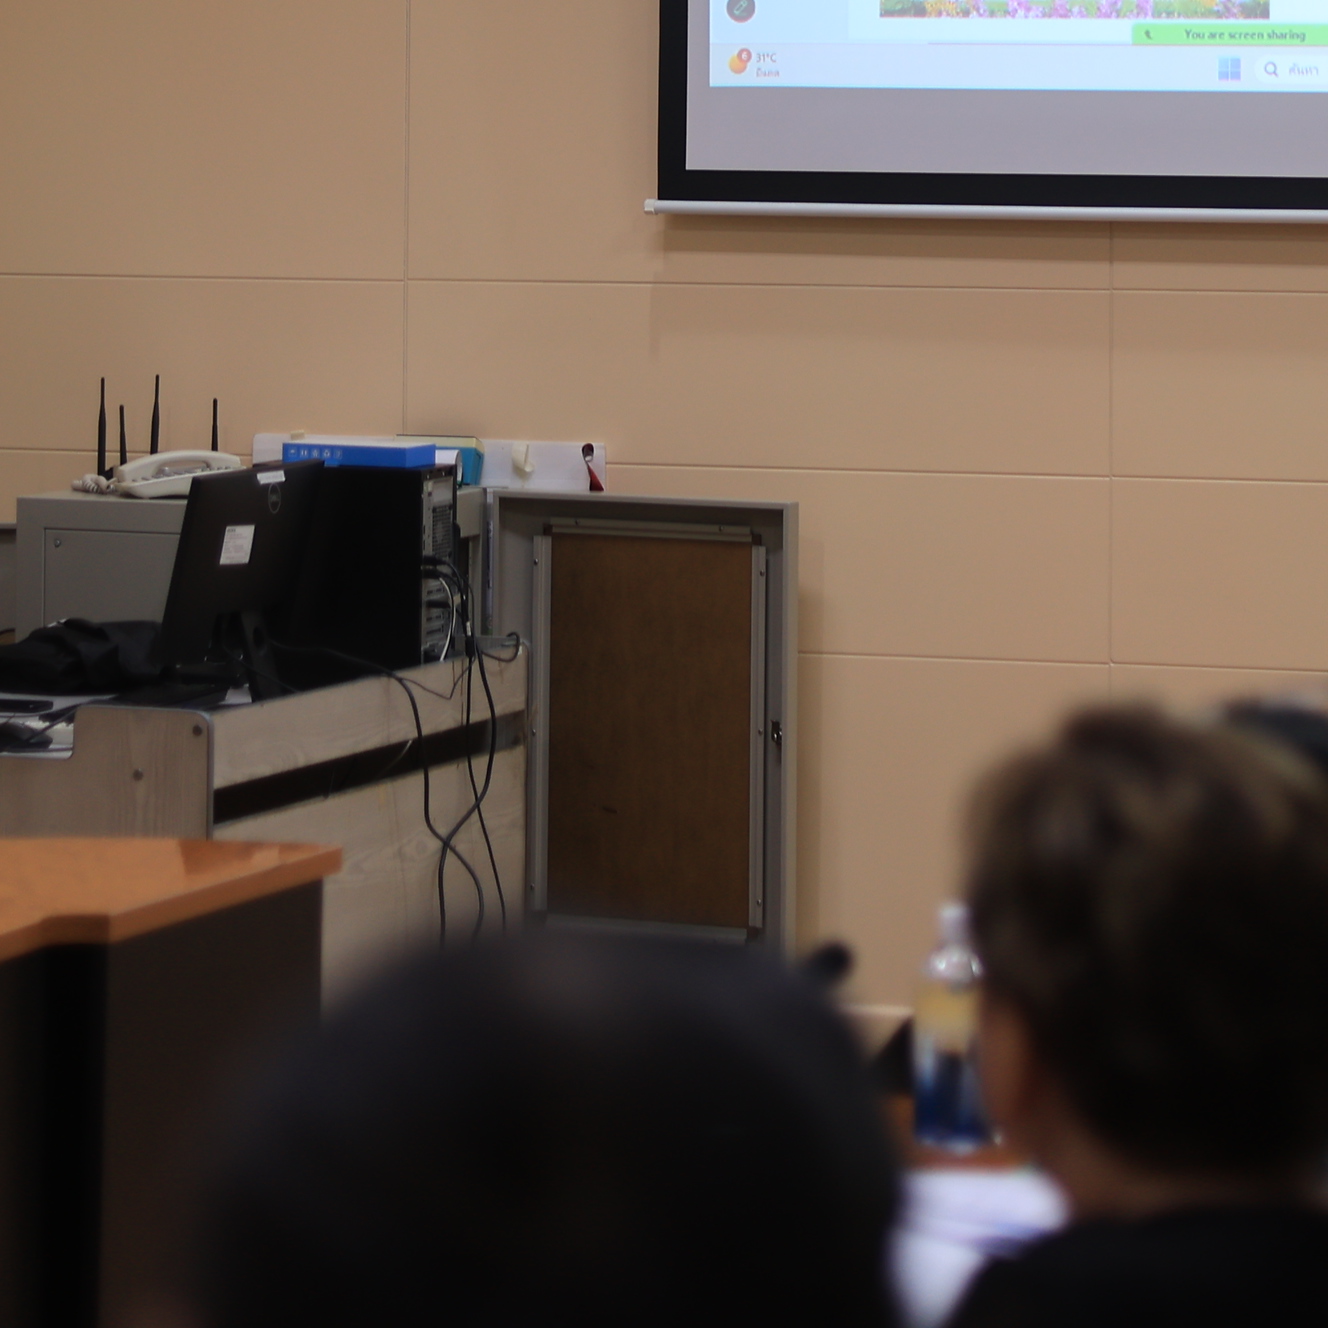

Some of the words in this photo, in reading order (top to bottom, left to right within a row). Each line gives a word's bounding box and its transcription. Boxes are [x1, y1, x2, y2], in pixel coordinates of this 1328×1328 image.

[1185, 28, 1205, 40] You
[1207, 31, 1224, 40] are
[1228, 31, 1264, 40] screen
[1267, 28, 1306, 43] sharing
